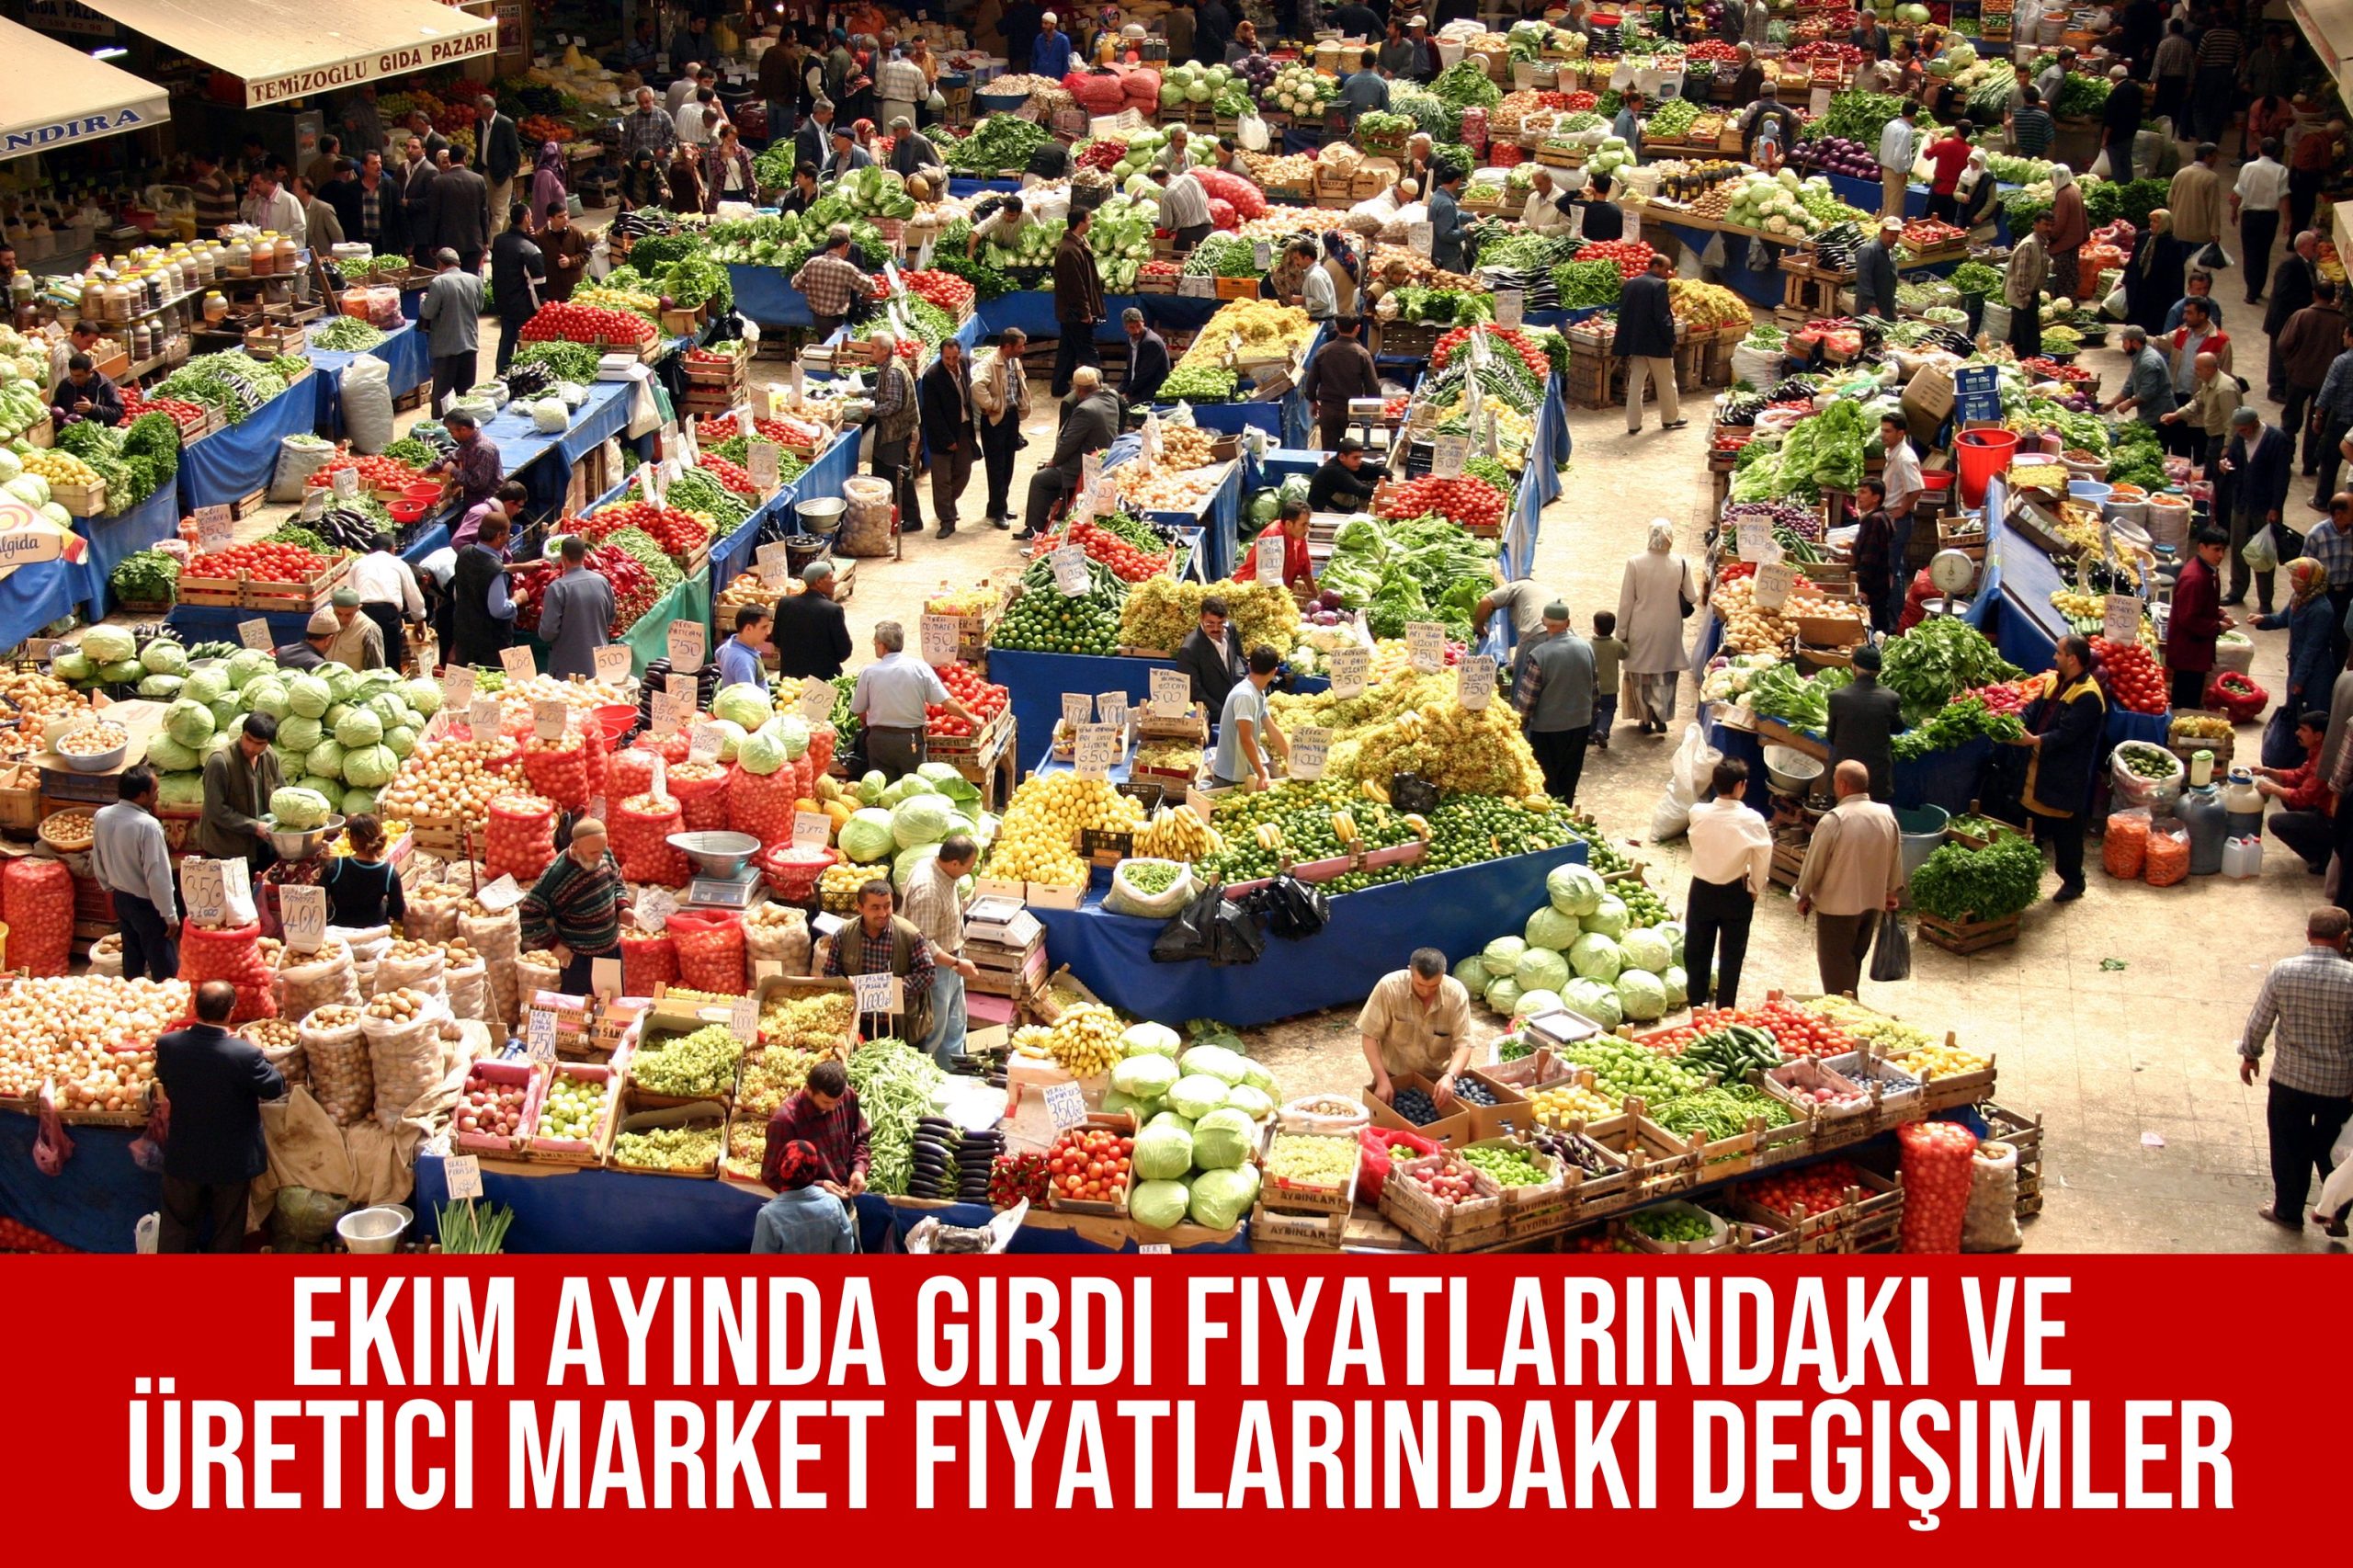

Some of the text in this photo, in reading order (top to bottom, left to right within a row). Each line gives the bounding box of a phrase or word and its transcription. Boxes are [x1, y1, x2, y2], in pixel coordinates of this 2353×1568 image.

[379, 47, 423, 74] GIDA
[432, 32, 494, 61] PAZARI
[0, 533, 40, 560] lgida
[2109, 614, 2134, 629] 500
[671, 638, 701, 657] 750
[923, 632, 953, 646] 350
[598, 651, 626, 669] 500
[1411, 649, 1438, 662] 750
[1335, 675, 1363, 686] 750
[1463, 683, 1490, 696] 750
[801, 689, 834, 710] 400
[1152, 690, 1183, 704] 500
[1078, 749, 1111, 763] 650
[796, 822, 810, 835] 5
[184, 875, 223, 909] 350
[280, 900, 324, 937] 400
[529, 1031, 555, 1058] 750
[1050, 1097, 1075, 1124] 350
